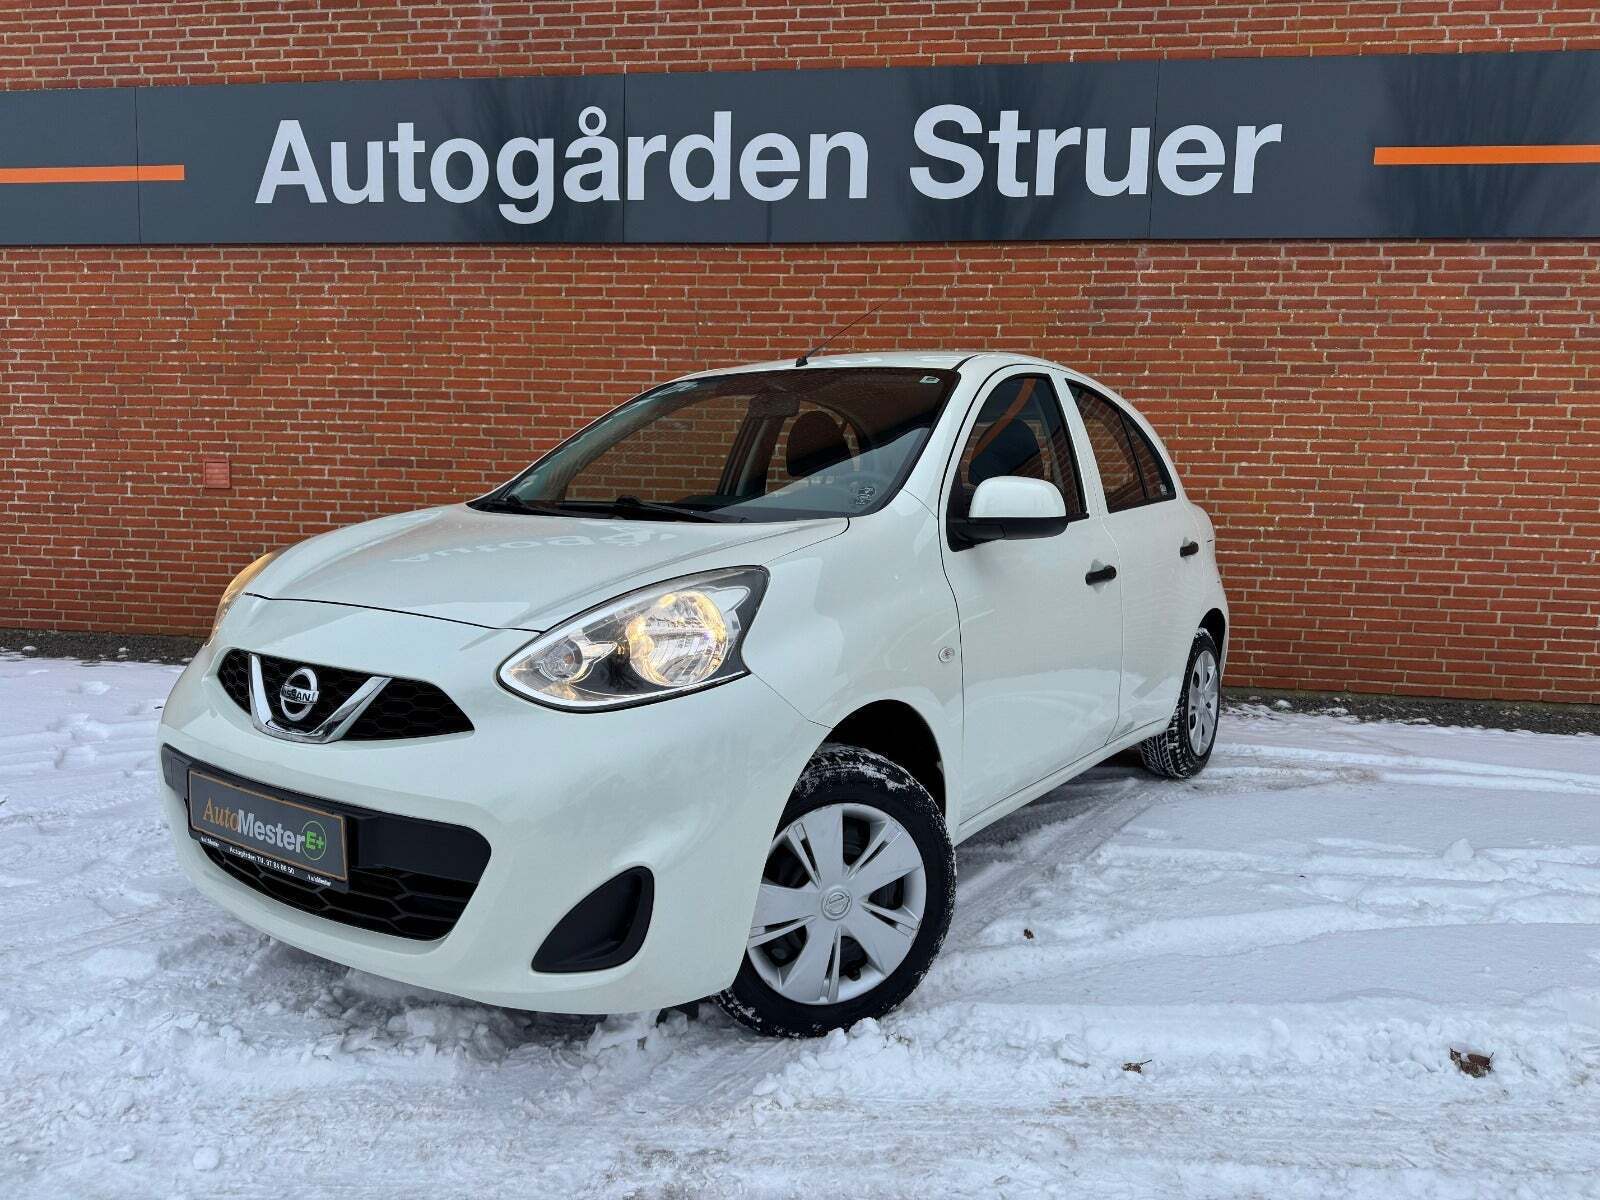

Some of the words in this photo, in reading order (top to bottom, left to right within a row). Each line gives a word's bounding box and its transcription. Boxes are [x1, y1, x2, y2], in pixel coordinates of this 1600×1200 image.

[255, 105, 869, 225] Autogården
[909, 104, 1283, 200] Struer
[281, 687, 311, 702] NISSAN
[203, 797, 305, 853] AutoMester
